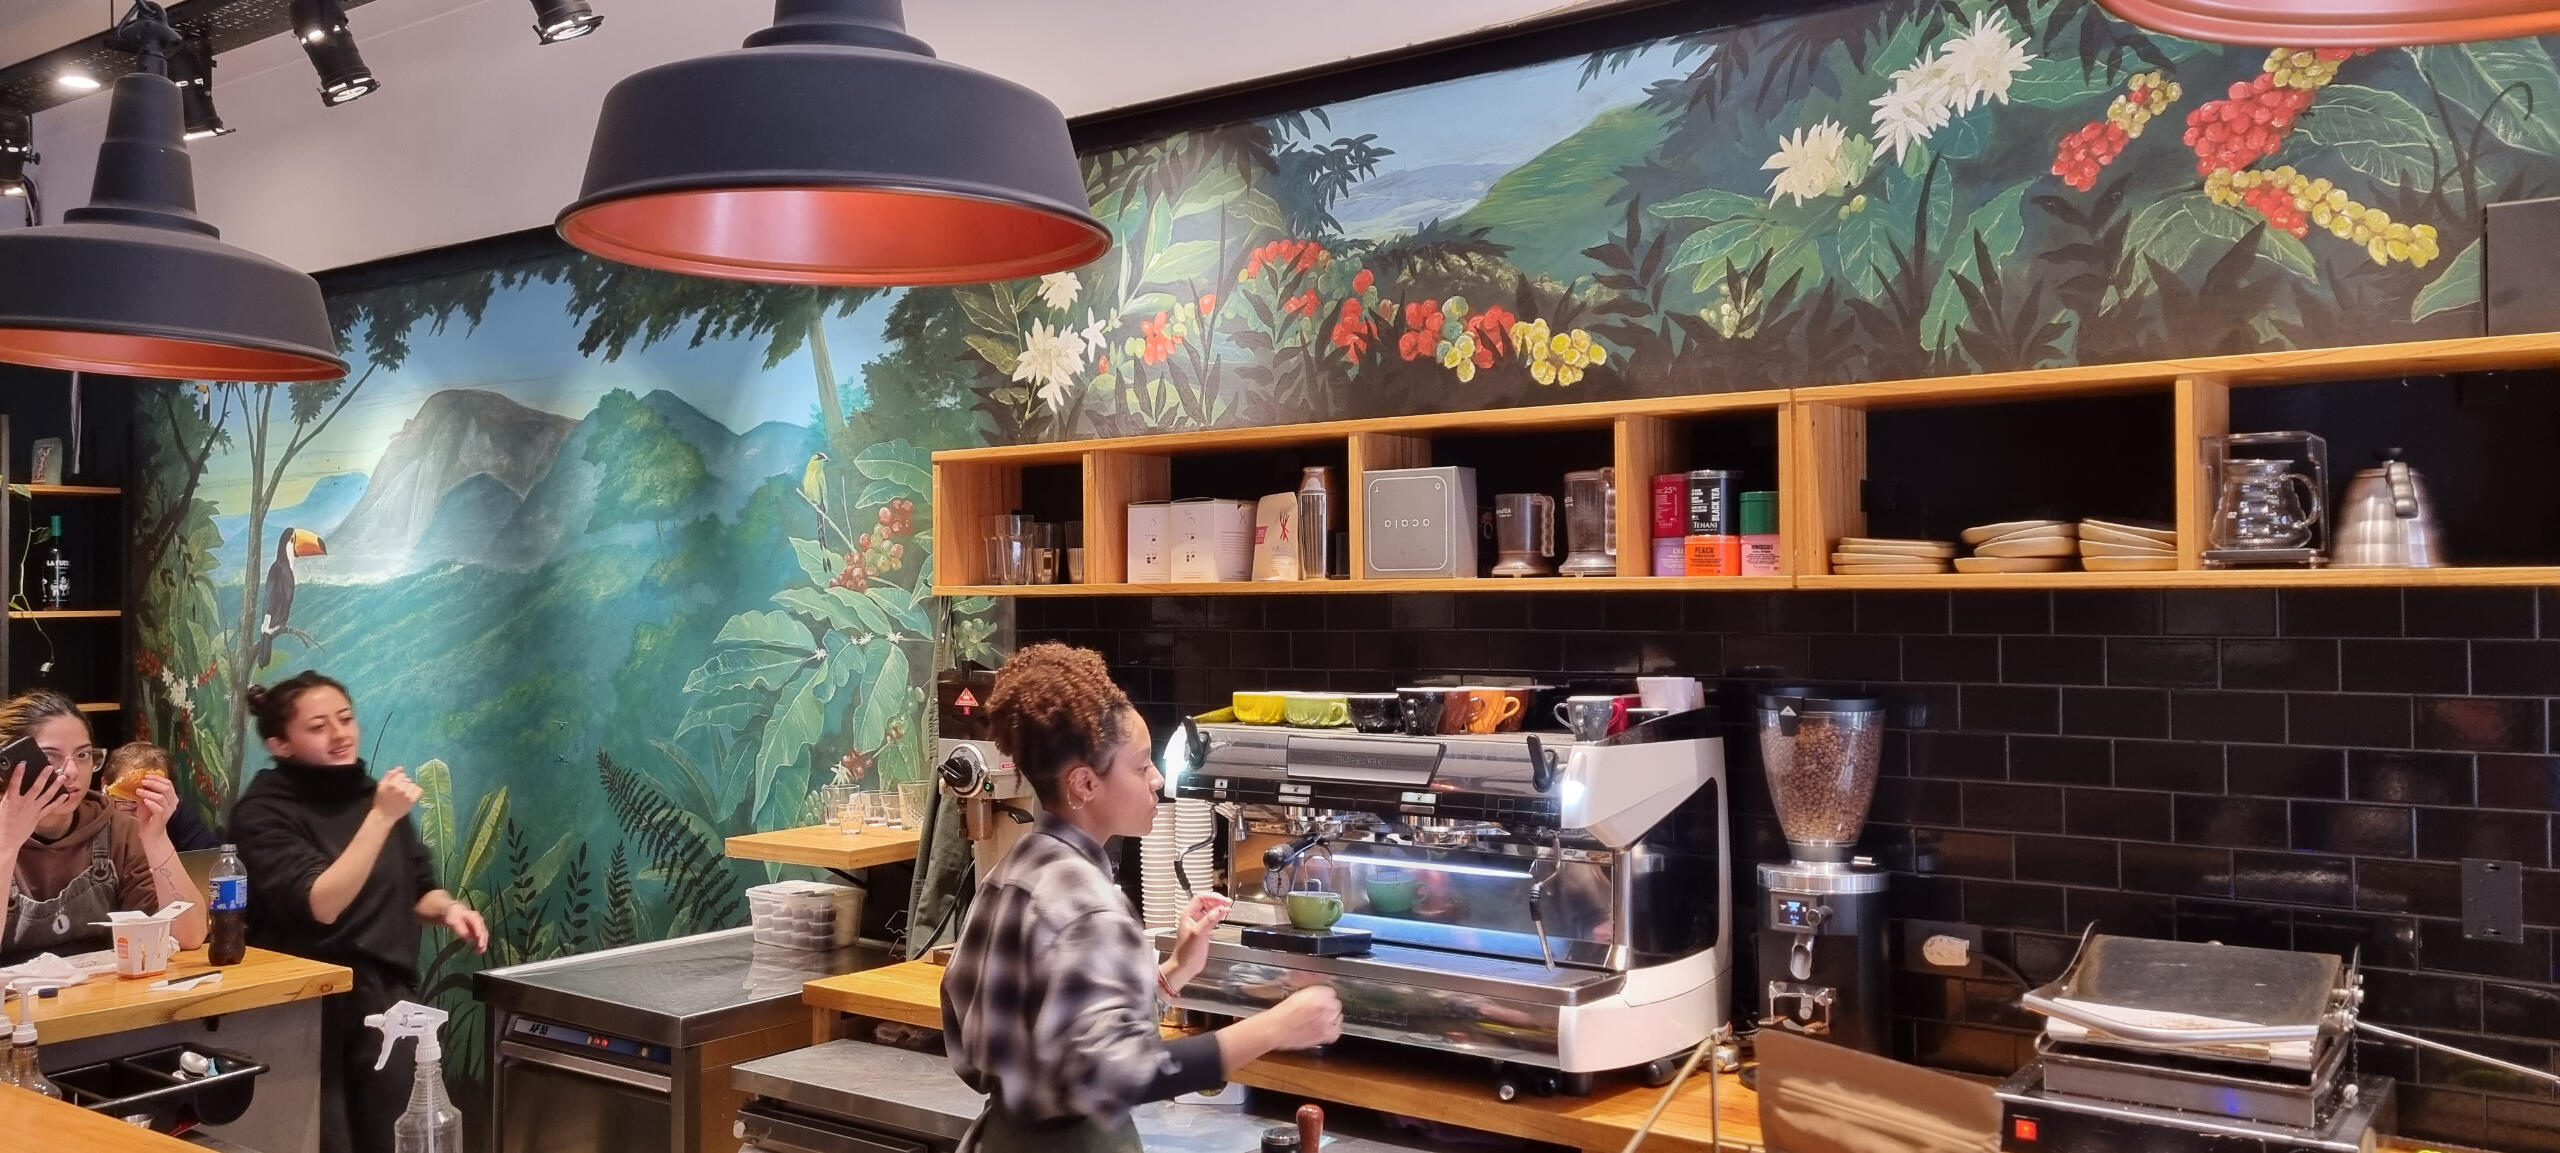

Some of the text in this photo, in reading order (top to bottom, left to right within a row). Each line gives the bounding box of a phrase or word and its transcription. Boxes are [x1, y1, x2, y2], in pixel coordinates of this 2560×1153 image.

[1711, 488, 1720, 521] BLACK TEA
[1693, 521, 1718, 529] TEHANI
[1694, 546, 1715, 555] PEACH
